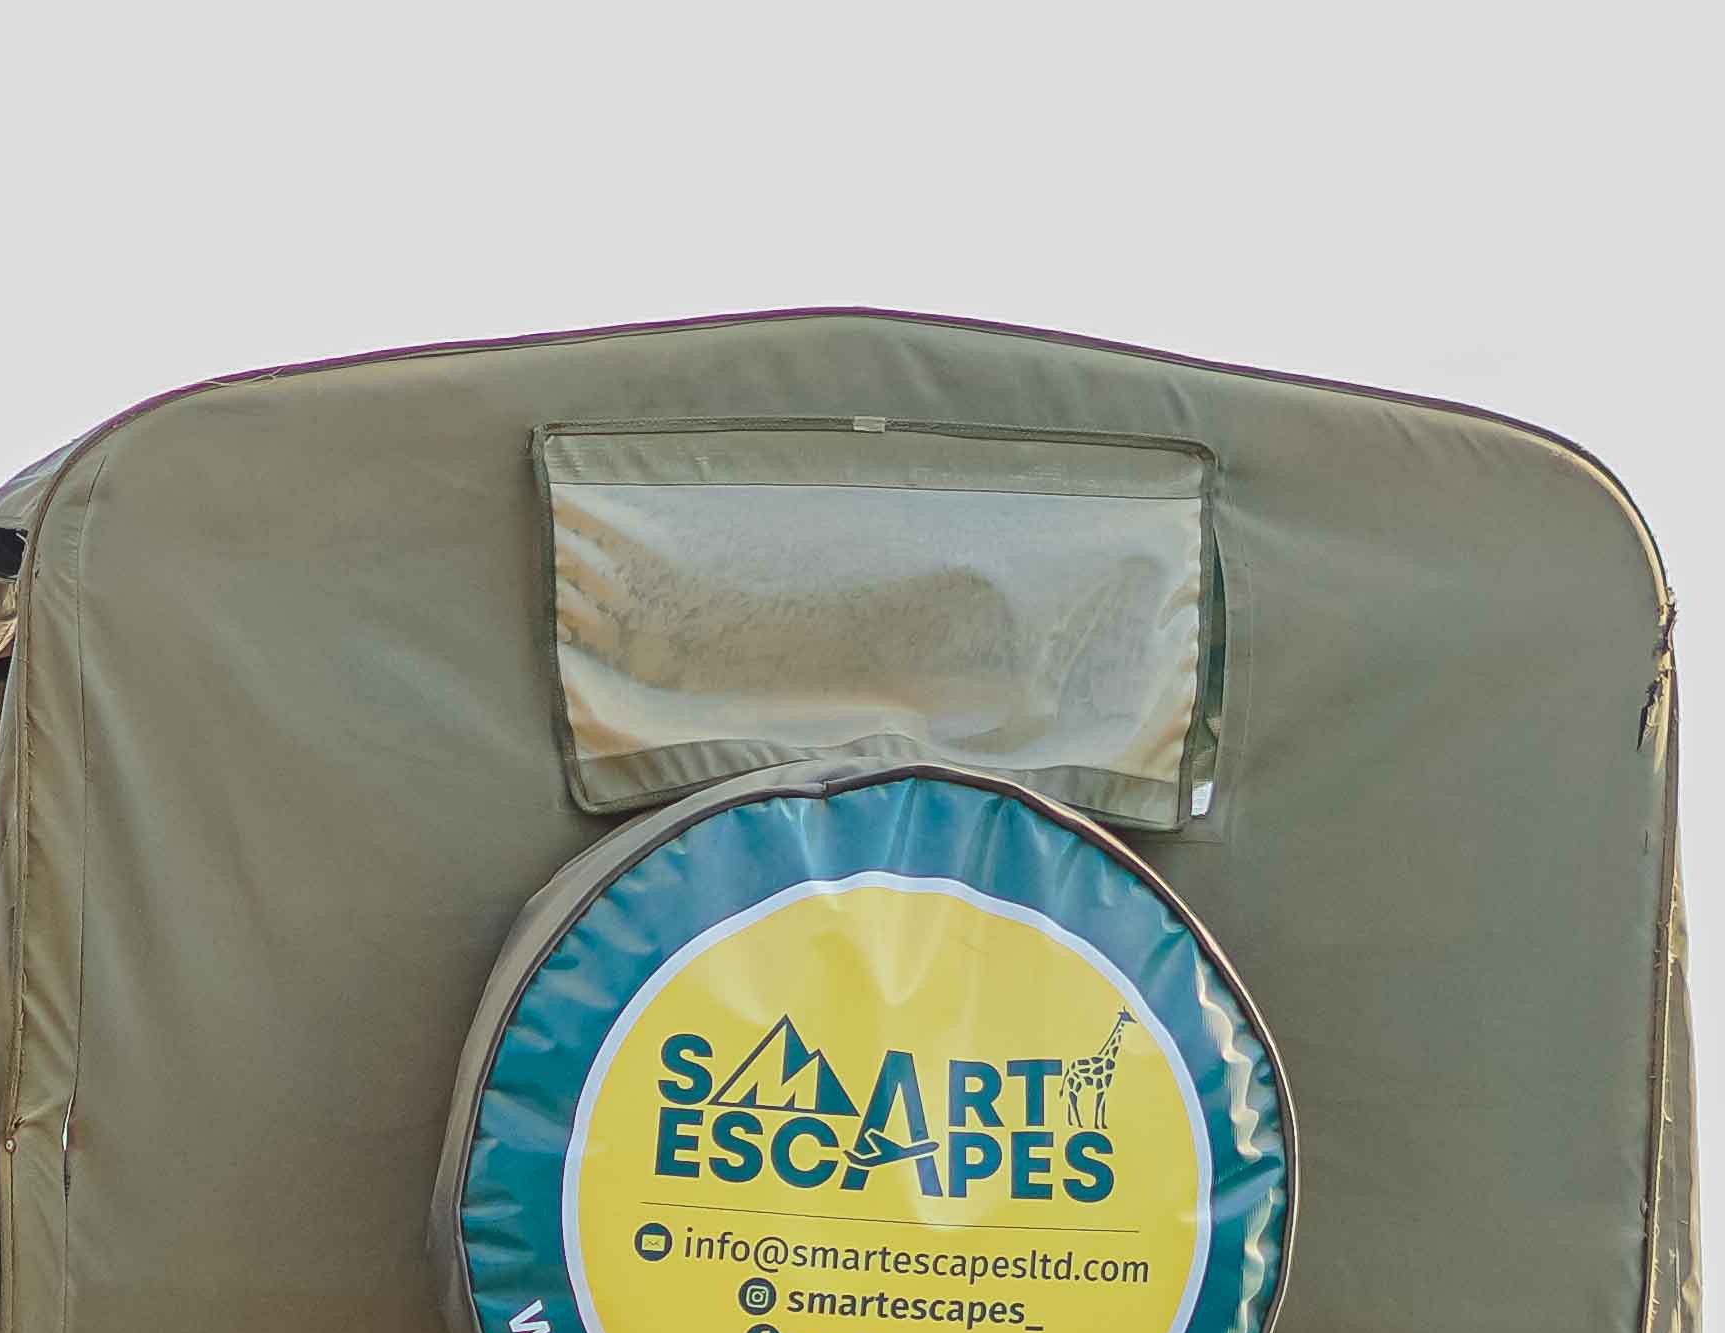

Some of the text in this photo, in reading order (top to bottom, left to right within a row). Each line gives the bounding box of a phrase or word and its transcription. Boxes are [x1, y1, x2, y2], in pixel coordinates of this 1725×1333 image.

[656, 1014, 1063, 1128] SMART
[654, 1107, 1115, 1203] ESCAPES
[685, 1227, 1150, 1285] info@smartescapesltd.com
[787, 1291, 1044, 1332] smartescapes_
